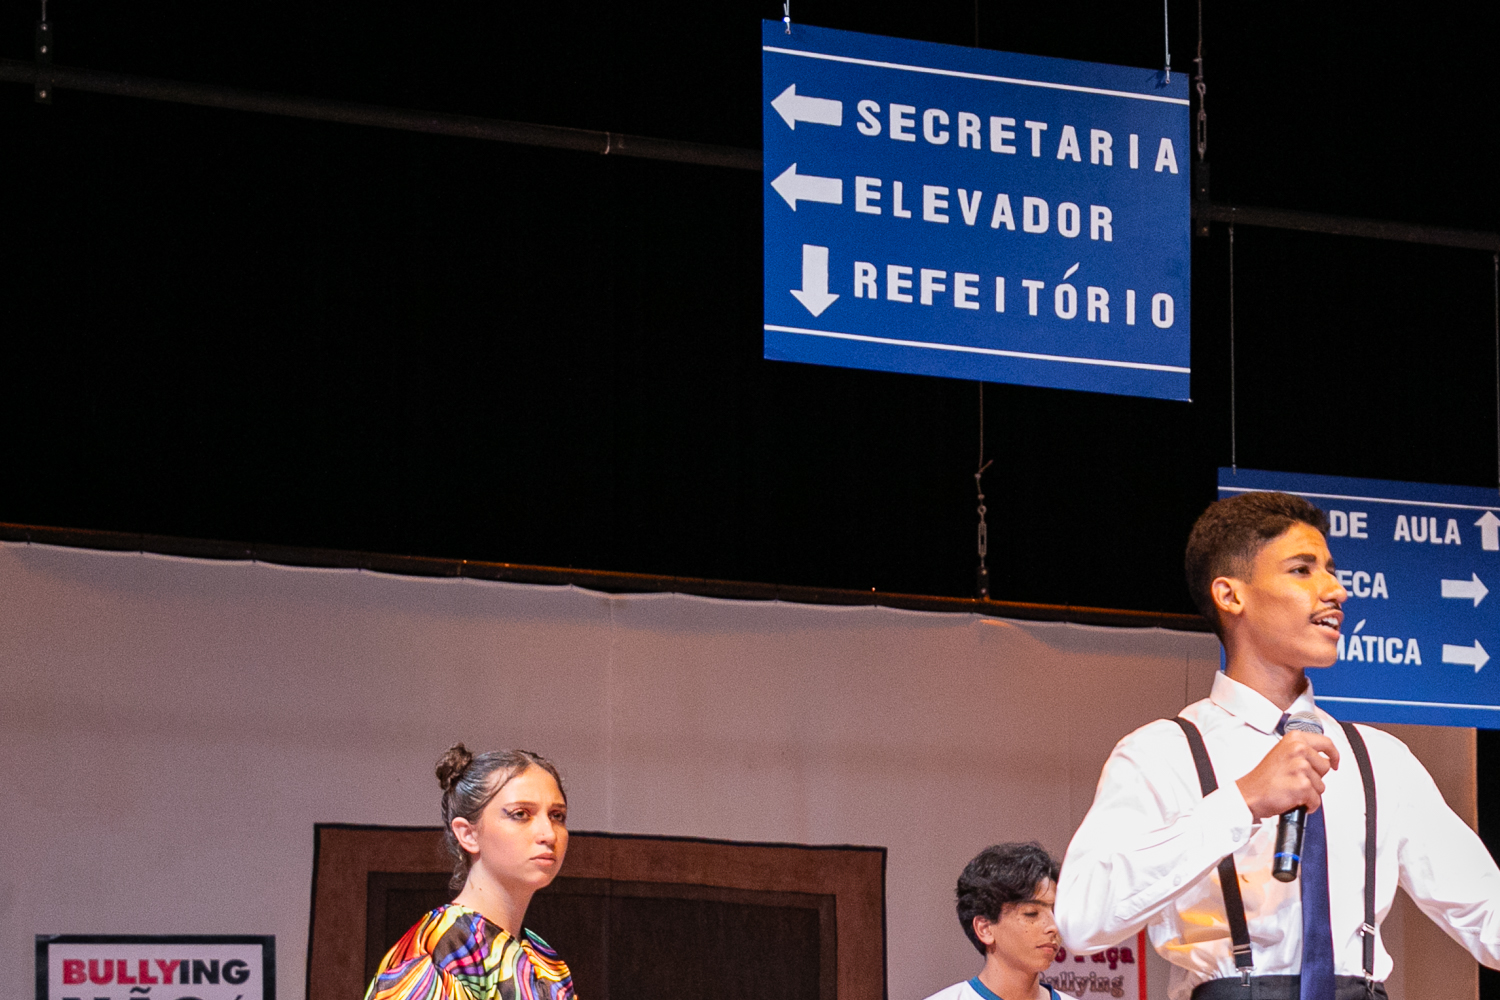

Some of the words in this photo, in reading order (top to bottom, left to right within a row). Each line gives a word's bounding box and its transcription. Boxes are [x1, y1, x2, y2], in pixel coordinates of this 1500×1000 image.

[856, 99, 1179, 174] SECRETARIA
[855, 176, 1113, 242] ELEVADOR
[854, 260, 1175, 329] REFEITÓRIO
[1329, 510, 1368, 539] DE
[1394, 515, 1461, 545] AULA
[1335, 569, 1389, 599] ECA
[62, 958, 251, 985] BULLYING
